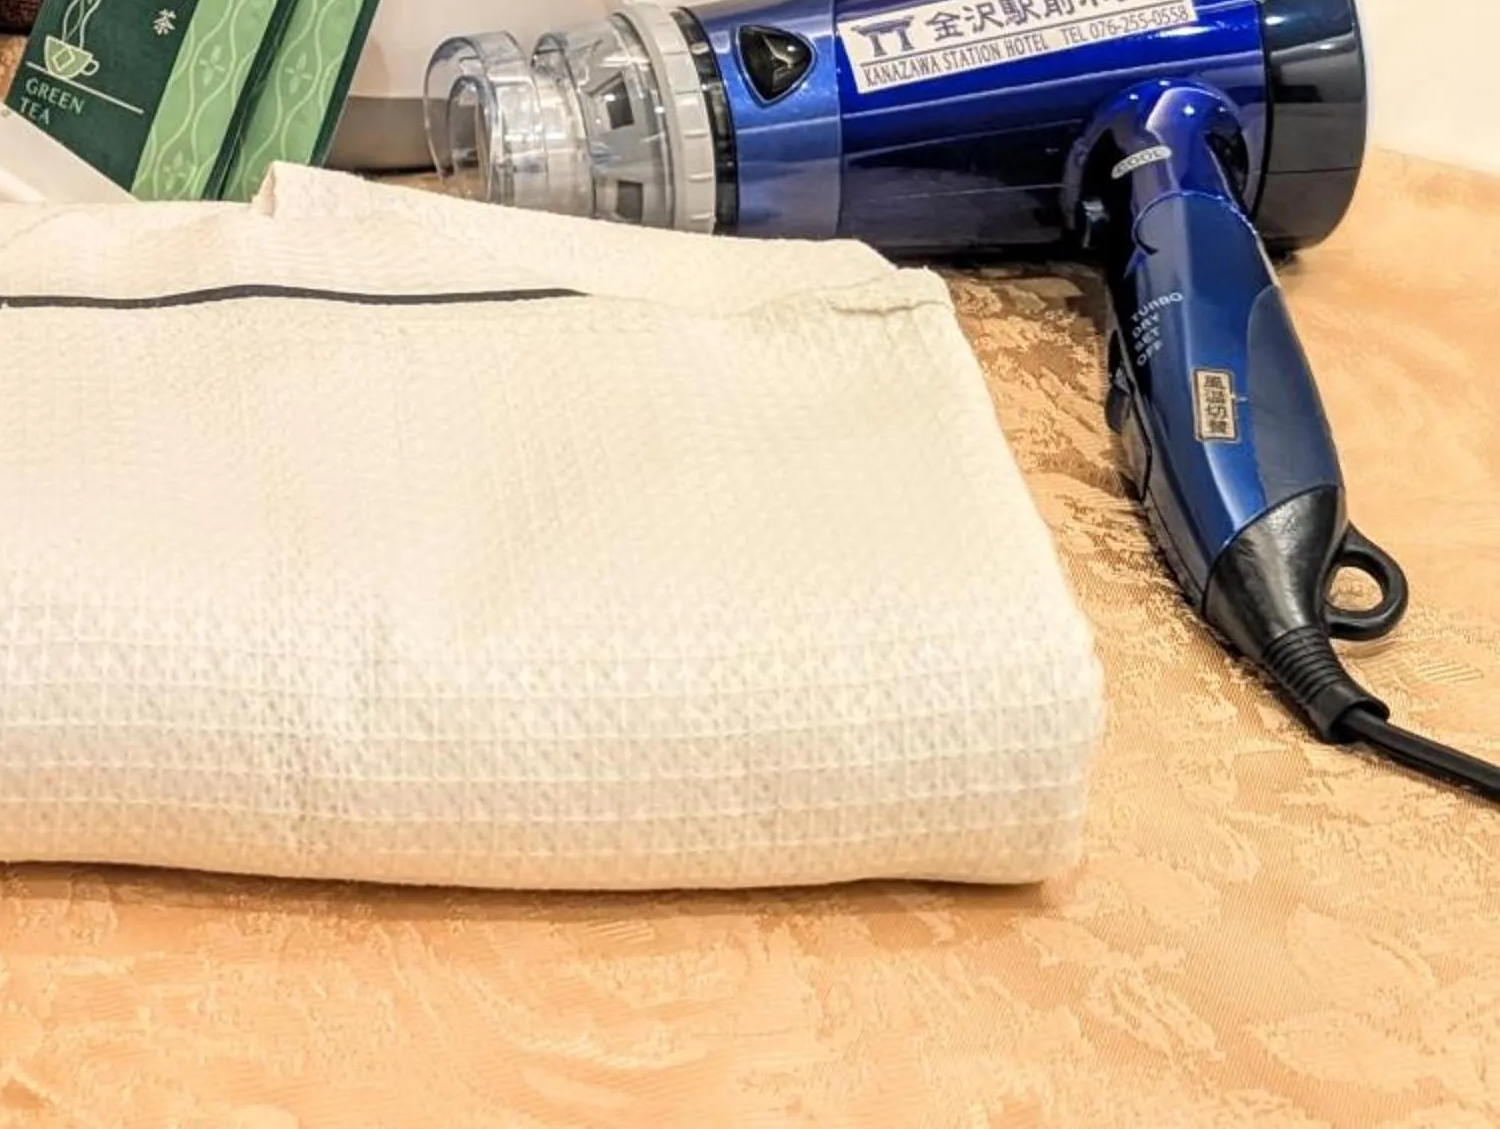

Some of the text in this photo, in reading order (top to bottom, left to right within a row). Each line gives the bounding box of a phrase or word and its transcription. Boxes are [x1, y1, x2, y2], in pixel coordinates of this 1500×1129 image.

[864, 4, 1189, 87] KANAZAWA STATION HOTEL TEL 076-255-0558
[25, 77, 85, 115] GREEN
[19, 97, 51, 126] TEA
[1131, 292, 1183, 322] TURBO
[1132, 312, 1160, 339] DRY
